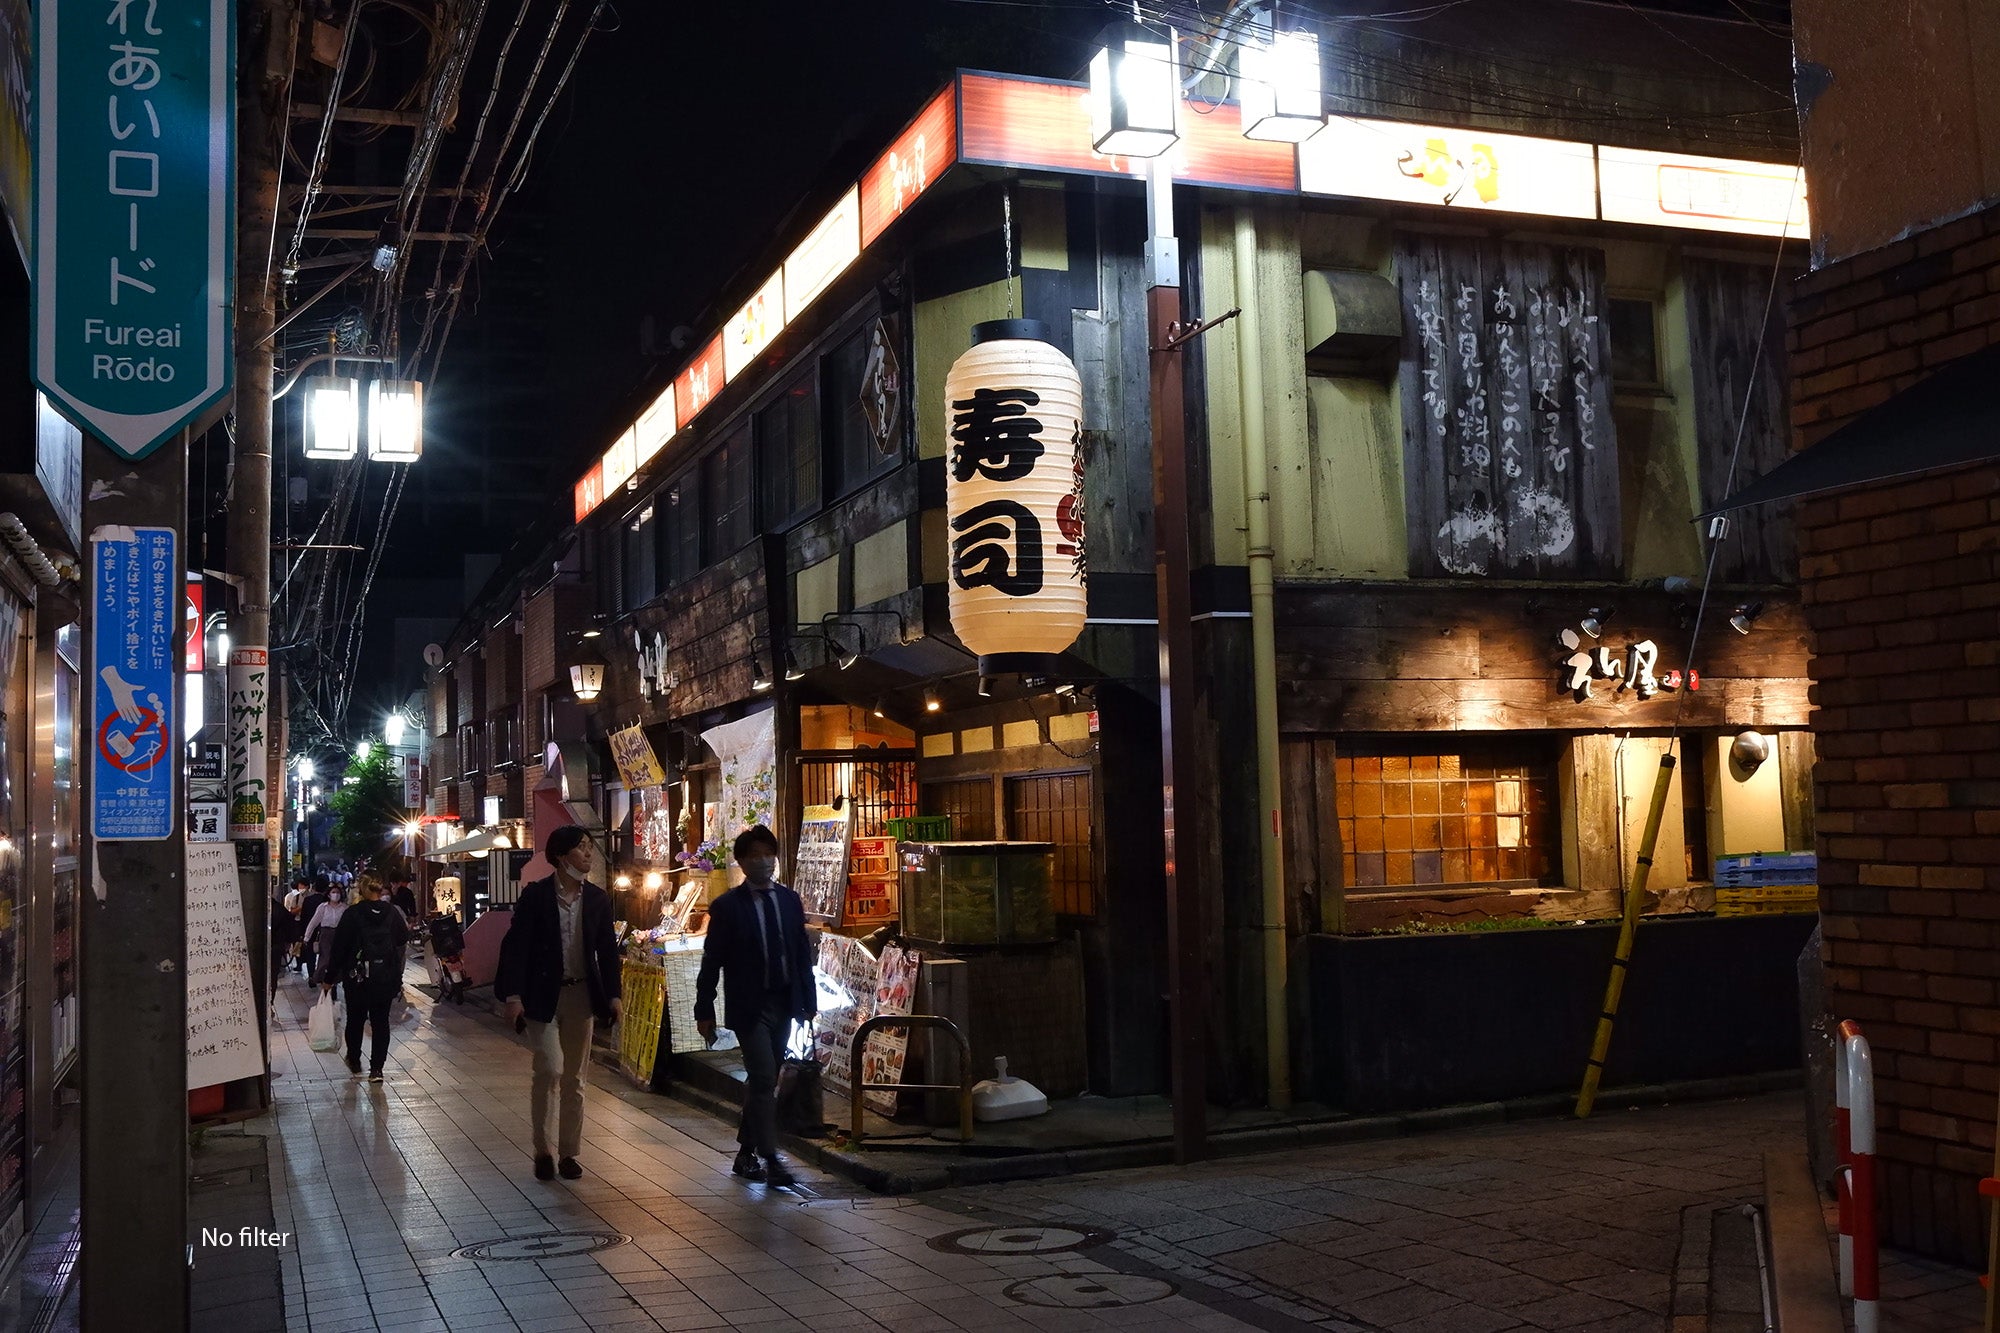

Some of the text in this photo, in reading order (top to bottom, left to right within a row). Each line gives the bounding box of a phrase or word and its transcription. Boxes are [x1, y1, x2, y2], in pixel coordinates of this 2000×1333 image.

[107, 0, 163, 305] れあいロード
[84, 317, 182, 348] Fureai
[92, 354, 175, 383] Rōdo
[950, 388, 1045, 597] 寿司
[103, 541, 117, 612] めましょう。
[116, 787, 150, 797] 中野区
